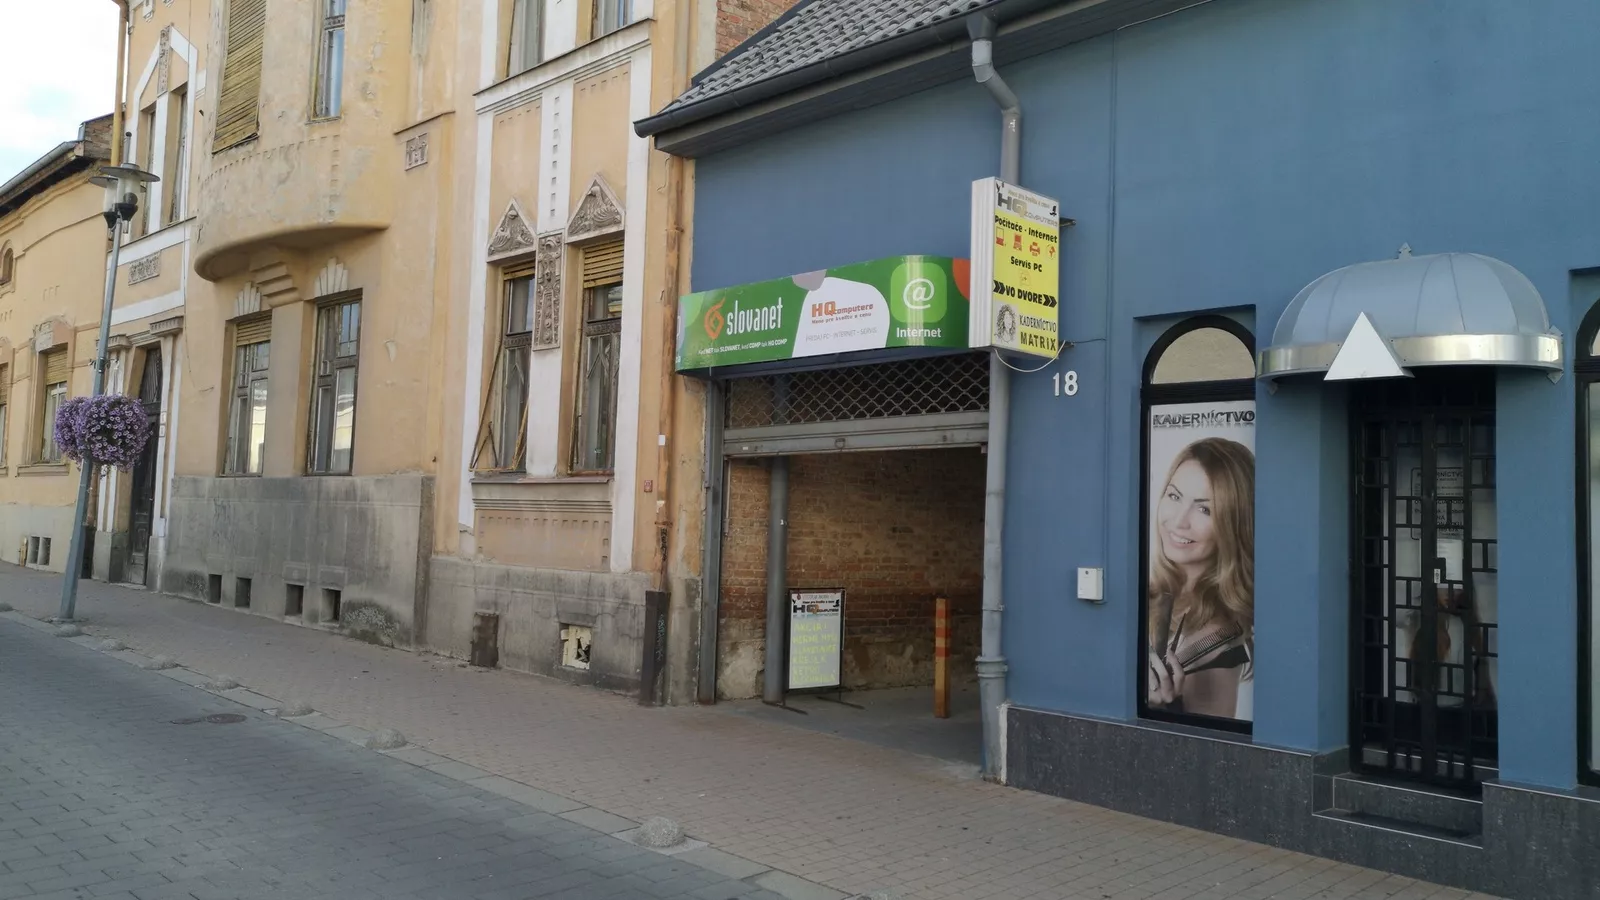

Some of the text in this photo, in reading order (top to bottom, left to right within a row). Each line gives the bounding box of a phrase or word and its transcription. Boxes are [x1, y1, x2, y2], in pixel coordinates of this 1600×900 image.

[1028, 227, 1057, 243] Internet
[1011, 256, 1042, 272] Servis PC
[1005, 285, 1042, 304] VO DVORE
[726, 297, 783, 335] slovanet
[1019, 315, 1057, 332] KADERNÍCTVO
[896, 327, 941, 338] Internet
[1020, 331, 1056, 351] MATRIX
[1053, 370, 1078, 396] 18
[1152, 410, 1255, 426] KADERNÍCTVO
